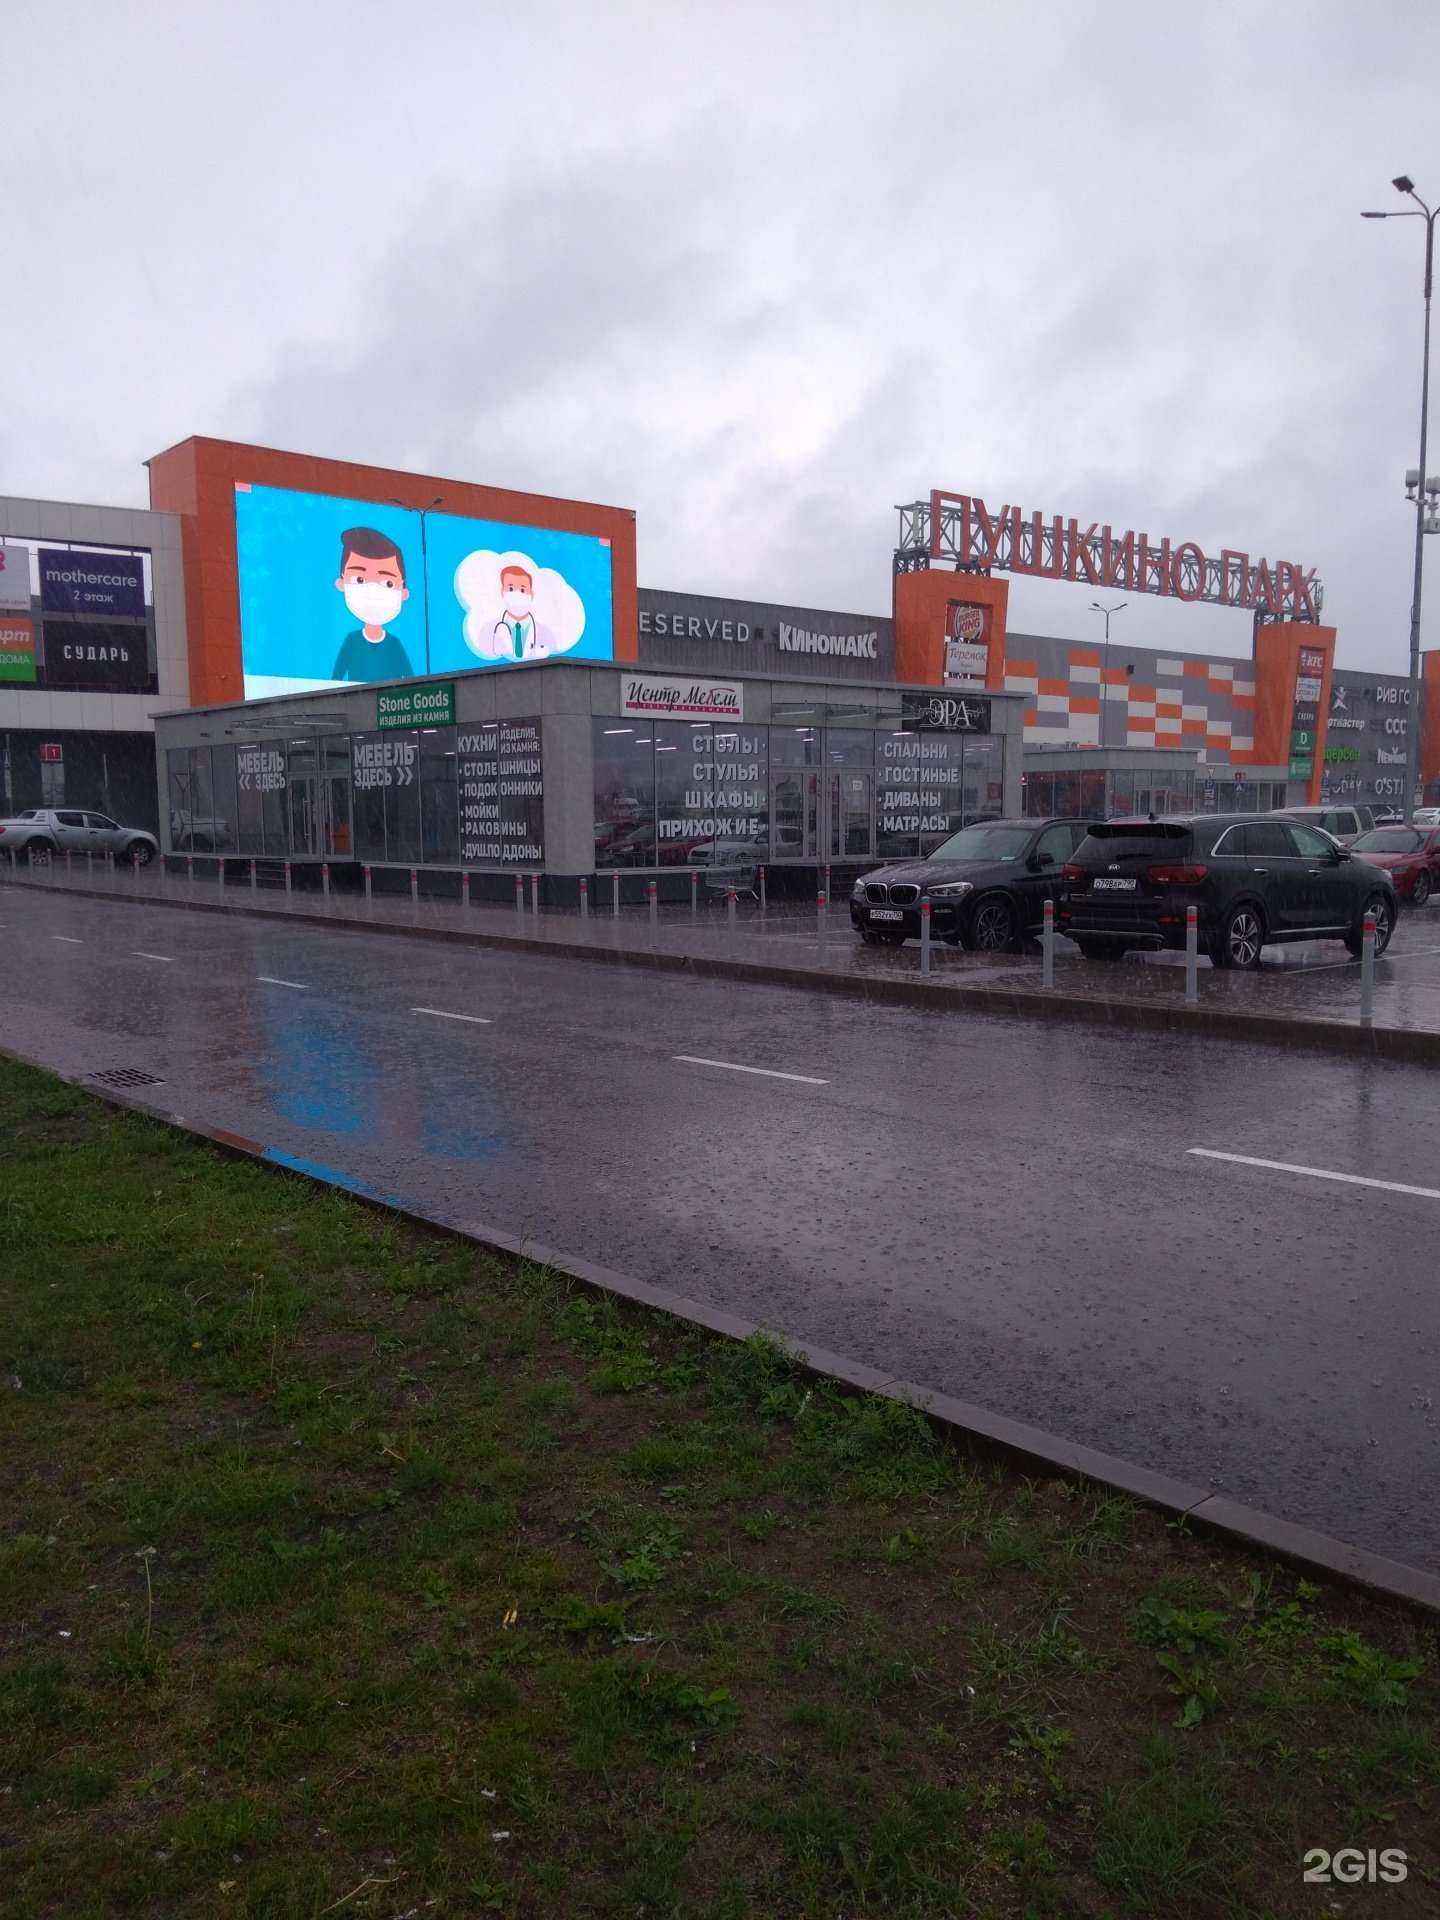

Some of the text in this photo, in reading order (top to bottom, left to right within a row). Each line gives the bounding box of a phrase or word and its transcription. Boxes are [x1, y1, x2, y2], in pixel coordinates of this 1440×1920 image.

[930, 489, 1318, 616] ПУШКИНО ПАРК
[46, 569, 138, 588] mothercare
[73, 590, 114, 603] 2 этаж
[639, 611, 750, 642] ESERVED
[779, 622, 878, 659] КИНОМАКС
[63, 645, 130, 662] СУДАРЬ
[379, 690, 449, 712] Stone Goods
[627, 682, 680, 712] Центр
[683, 686, 738, 707] Мебели
[379, 711, 450, 726] ИЗДЕЛИЯ ИЗ КАМНЯ
[500, 727, 536, 740] ИЗДЕЛИЯ
[457, 734, 498, 753] КУХНИ
[692, 735, 758, 754] СТОЛЫ
[884, 742, 948, 759] СПАЛЬНИ
[237, 751, 285, 774] МЕБЕЛЬ
[354, 742, 414, 768] МЕБЕЛЬ
[354, 767, 392, 790] ЗДЕСЬ
[693, 763, 759, 781] СТУЛЬЯ
[885, 767, 960, 783] ГОСТИНЫЕ
[255, 773, 286, 792] ЗДЕСЬ
[685, 791, 758, 809] ШКАФЫ
[883, 791, 941, 809] ДИВАНЫ
[465, 802, 499, 819] МОЙКИ
[465, 822, 527, 836] РАКОВИНЫ
[660, 818, 759, 837] ПРИХОЖИЕ
[883, 816, 950, 832] МАТРАСЫ
